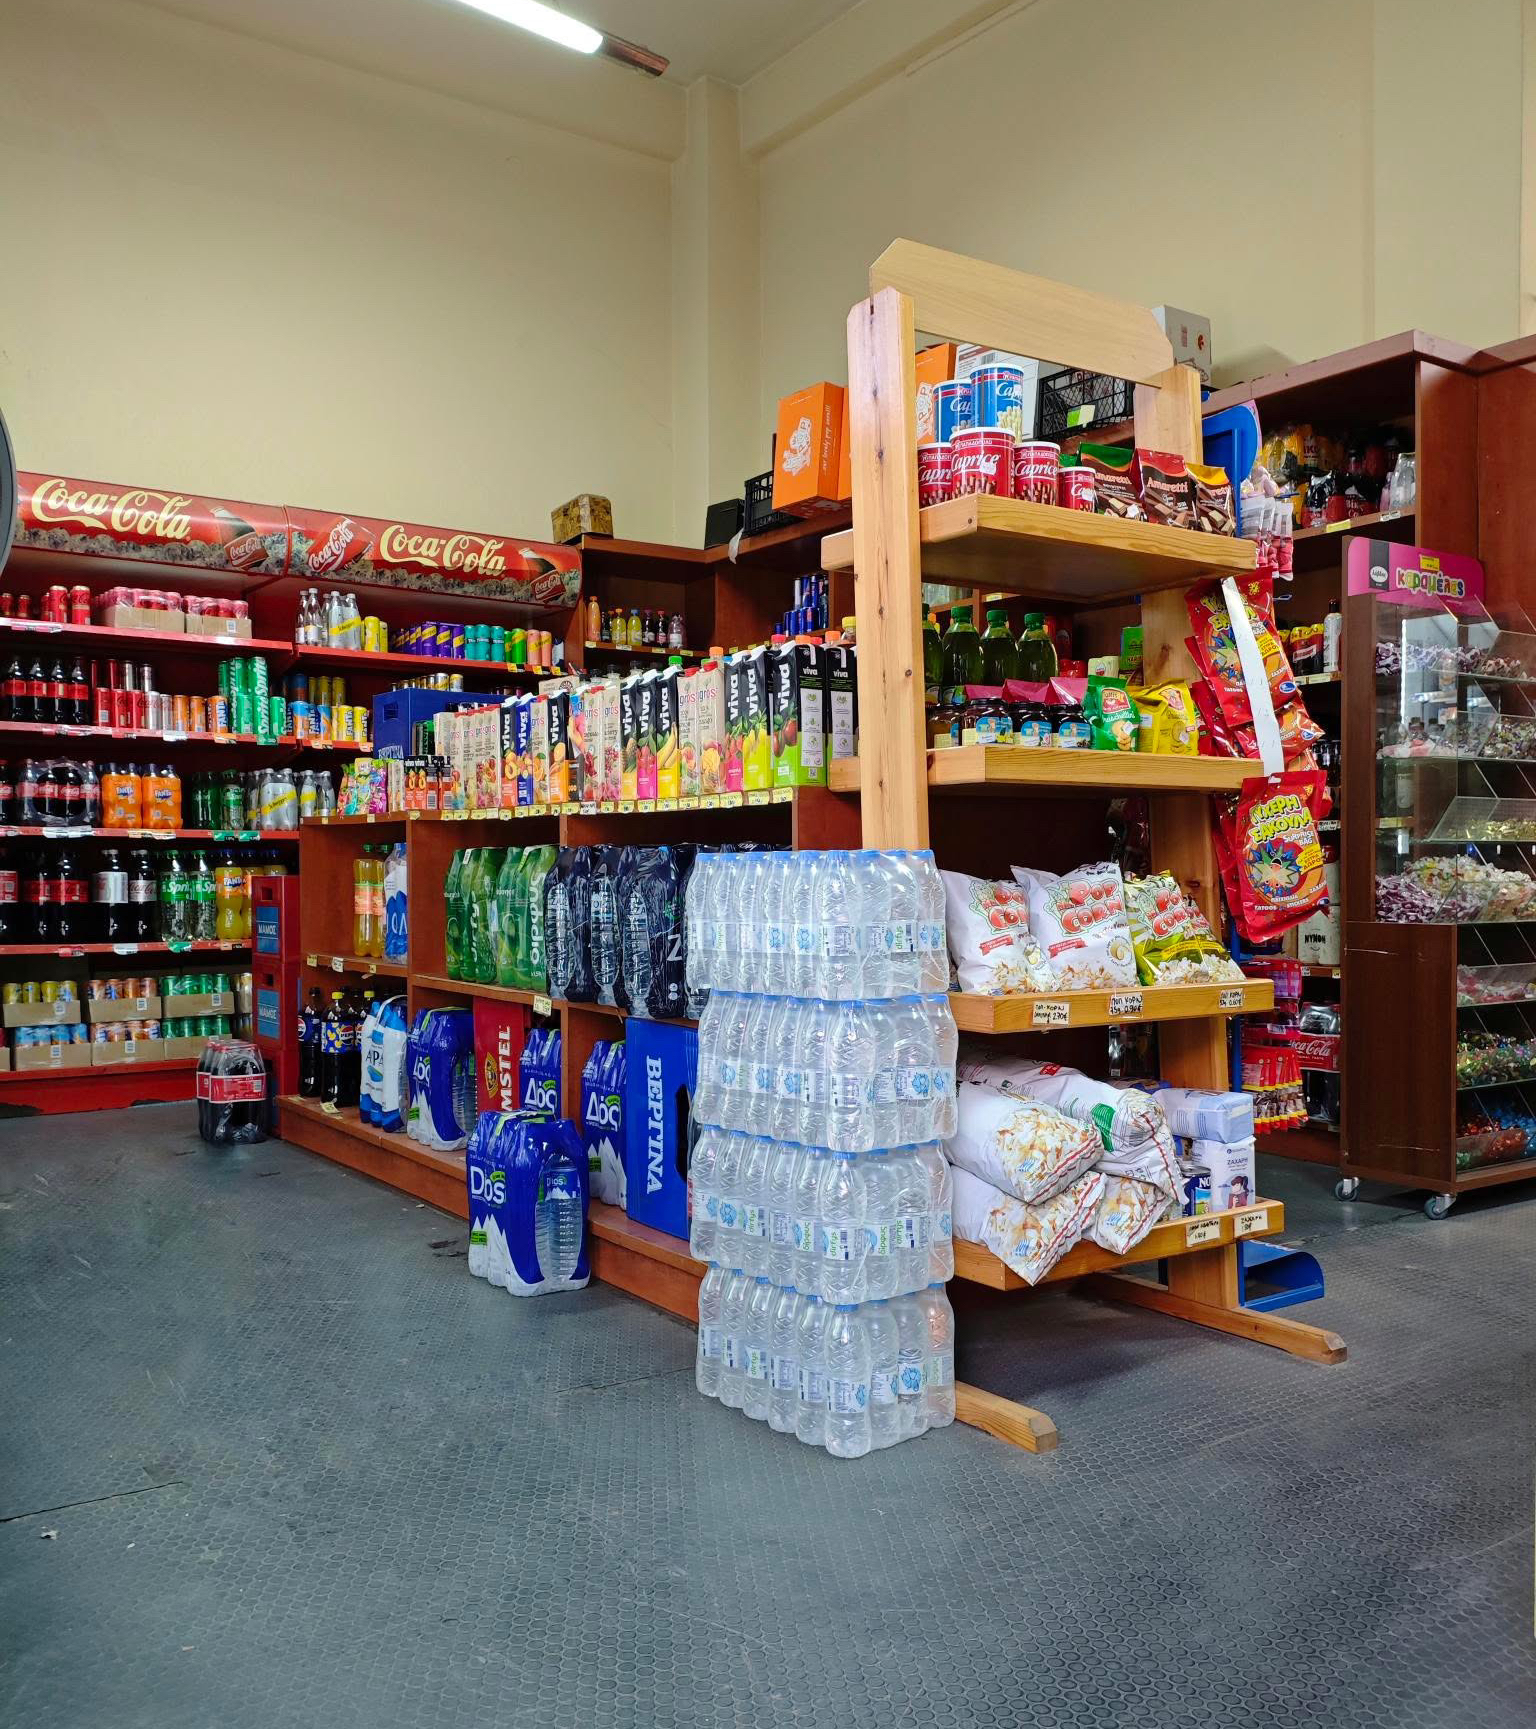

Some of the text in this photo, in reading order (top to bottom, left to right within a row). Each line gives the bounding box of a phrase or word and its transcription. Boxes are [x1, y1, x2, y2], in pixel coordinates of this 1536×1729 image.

[919, 465, 952, 485] Capri
[952, 453, 1001, 475] Caprice
[1015, 460, 1058, 479] Caprice
[1147, 476, 1189, 493] Amaretti
[32, 479, 192, 539] Coca-Cola
[308, 518, 354, 573] Coca-Cola
[380, 524, 507, 577] Coca-Cola
[728, 674, 738, 720] viva
[746, 669, 759, 717] viva
[778, 663, 791, 712] viva
[550, 705, 560, 744] viva
[622, 694, 633, 736] viva
[639, 691, 651, 734] viva
[660, 687, 670, 731] viva
[502, 714, 511, 751] viva
[518, 711, 529, 749] viva
[1283, 830, 1315, 843] SURPRISE
[1300, 837, 1313, 846] BAG
[994, 886, 1026, 905] PO
[1060, 896, 1124, 934] CORN
[500, 1026, 512, 1111] MSTEL
[646, 1055, 665, 1195] ΒΕΡΓΙΝΑ
